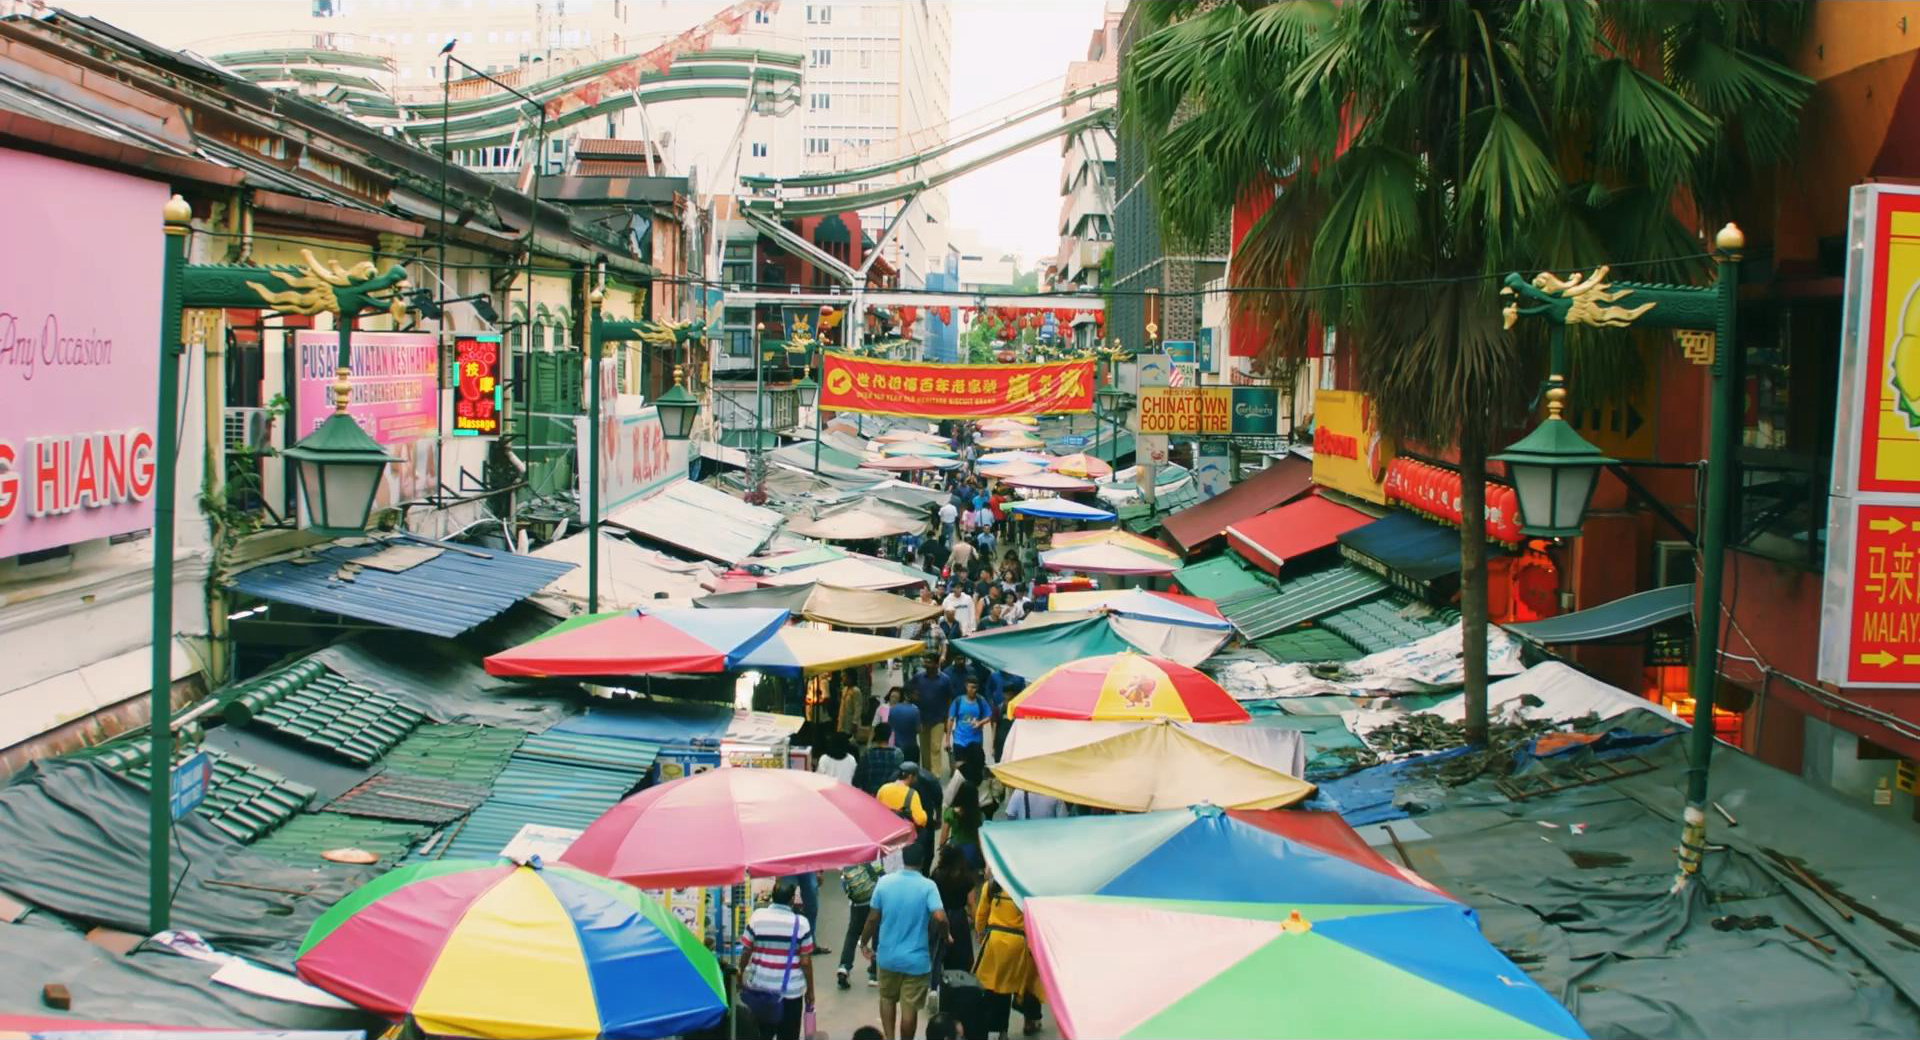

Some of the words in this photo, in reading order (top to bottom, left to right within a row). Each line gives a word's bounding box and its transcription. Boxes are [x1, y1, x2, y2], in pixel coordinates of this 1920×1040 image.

[41, 314, 112, 366] Occasion
[1163, 389, 1209, 397] RESTORAN
[1142, 397, 1228, 414] CHINATOWN
[1235, 402, 1273, 418] Carlsberg
[457, 416, 497, 431] Massage
[1141, 414, 1175, 430] FOOD
[1179, 414, 1228, 431] CENTRE
[30, 430, 156, 515] HIANG
[1864, 542, 1920, 605] 马来
[1862, 610, 1920, 643] MALAY
